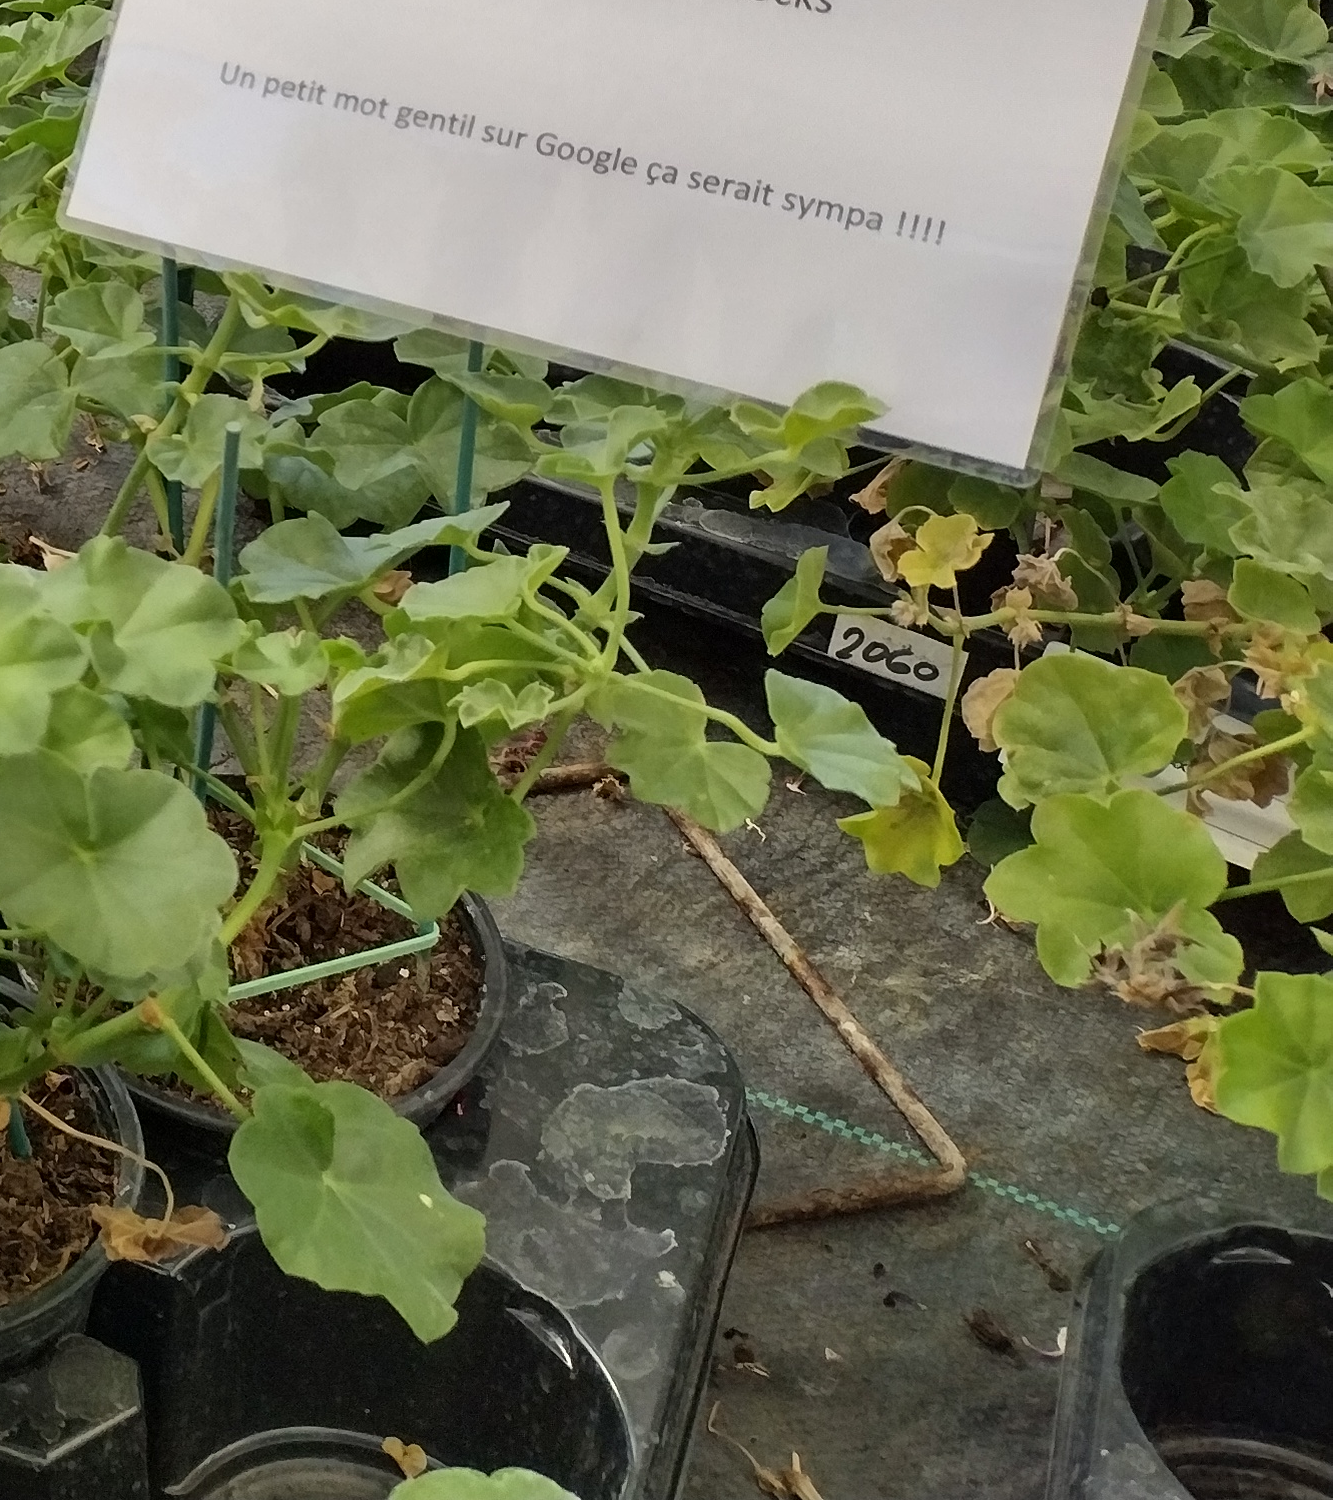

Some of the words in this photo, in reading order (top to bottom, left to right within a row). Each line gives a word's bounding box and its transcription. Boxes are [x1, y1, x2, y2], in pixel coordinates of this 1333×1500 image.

[220, 61, 256, 90] Un
[261, 76, 327, 106] petit
[333, 91, 390, 120] mot
[393, 105, 476, 139] gentil
[480, 124, 529, 150] sur
[535, 132, 638, 176] Google
[646, 161, 679, 186] ça
[686, 171, 775, 207] serait
[781, 192, 884, 232] sympa
[895, 210, 947, 246] !!!!
[834, 626, 941, 682] 2060
